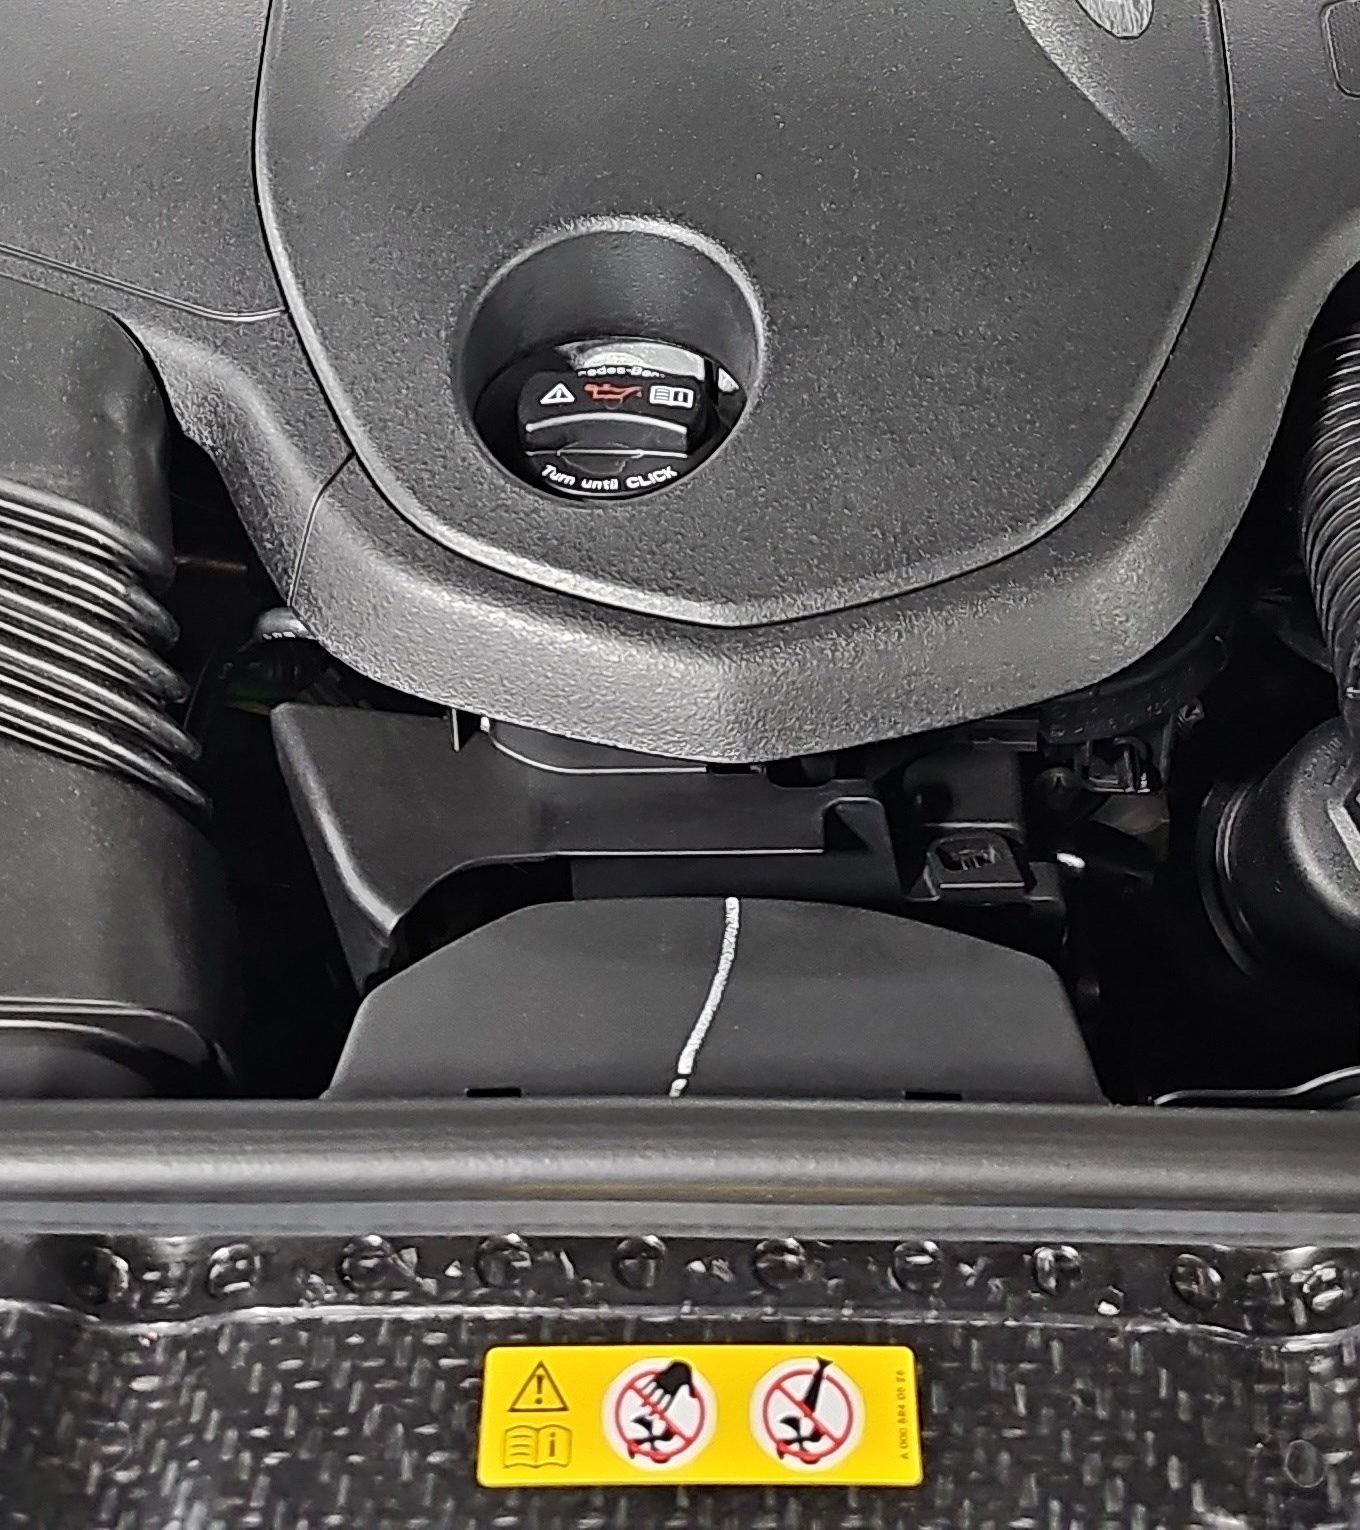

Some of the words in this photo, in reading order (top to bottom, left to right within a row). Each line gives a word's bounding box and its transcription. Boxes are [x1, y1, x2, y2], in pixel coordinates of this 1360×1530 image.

[541, 464, 576, 486] Turn
[581, 478, 619, 491] until
[626, 465, 678, 489] CLICK
